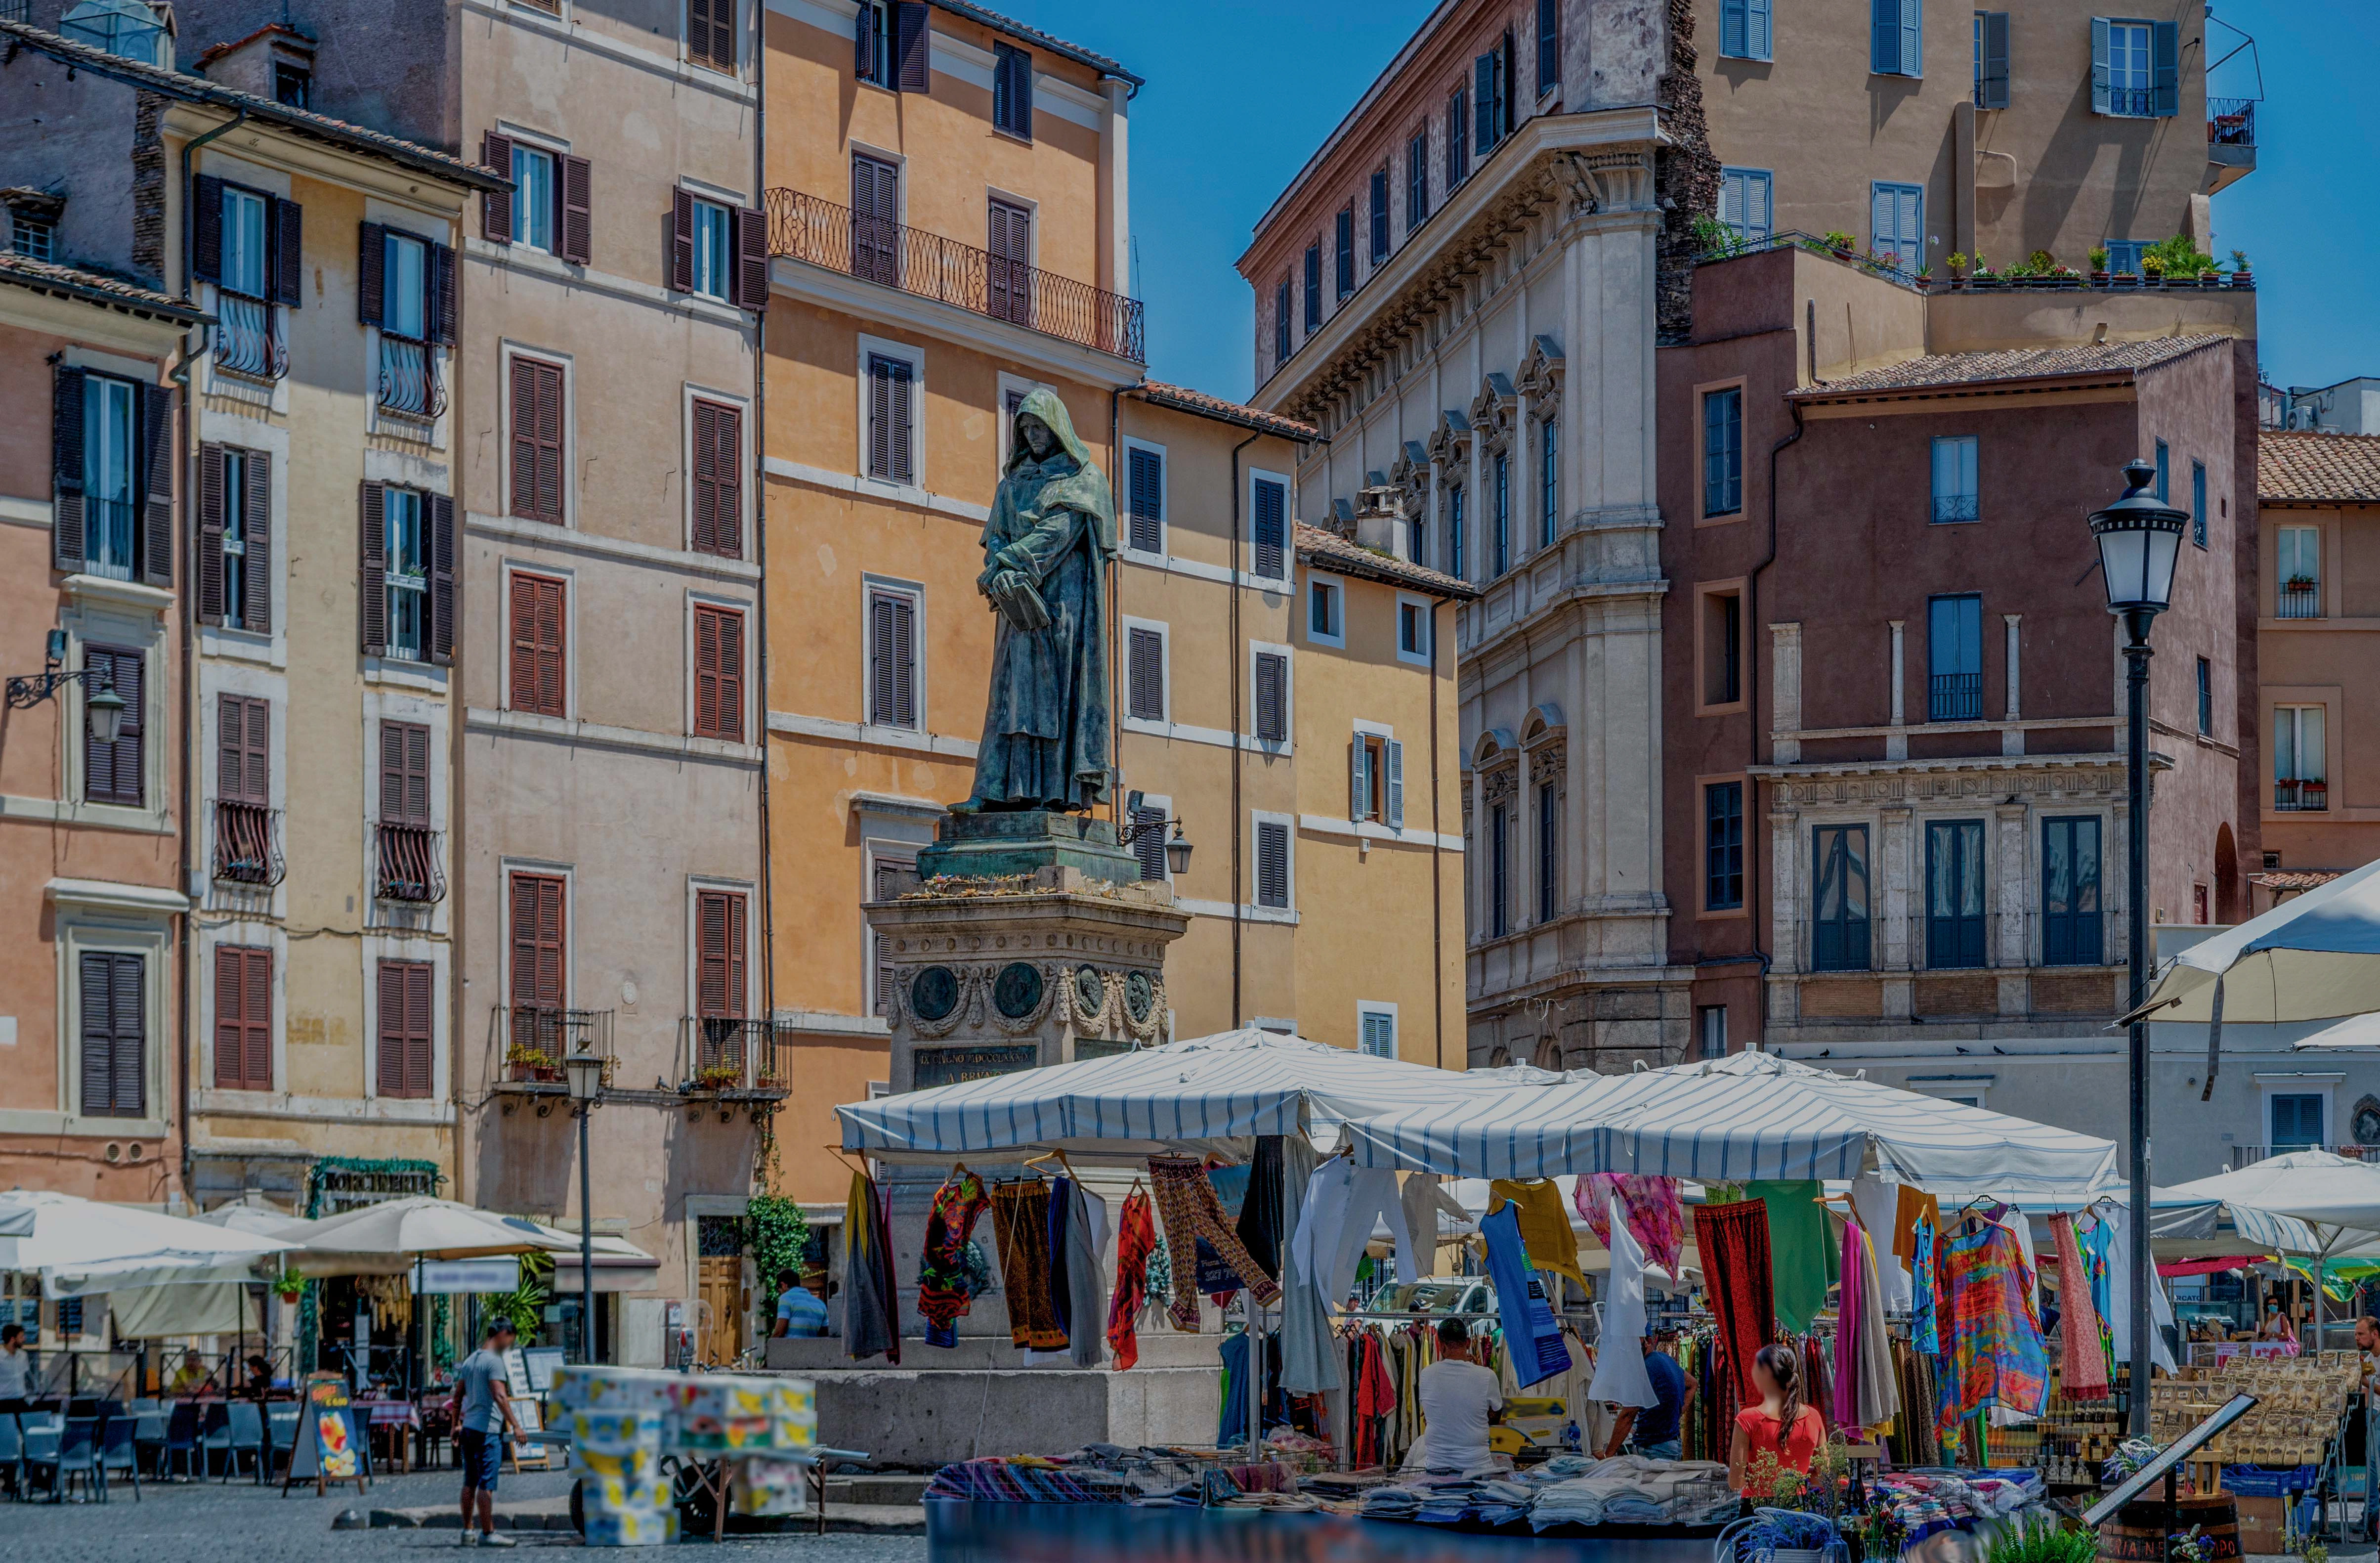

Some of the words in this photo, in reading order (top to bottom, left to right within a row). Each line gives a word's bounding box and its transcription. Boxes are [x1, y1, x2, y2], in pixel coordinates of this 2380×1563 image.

[921, 1055, 930, 1064] IX
[948, 1073, 955, 1084] A
[1205, 1269, 1222, 1282] 327
[1223, 1267, 1236, 1280] 70
